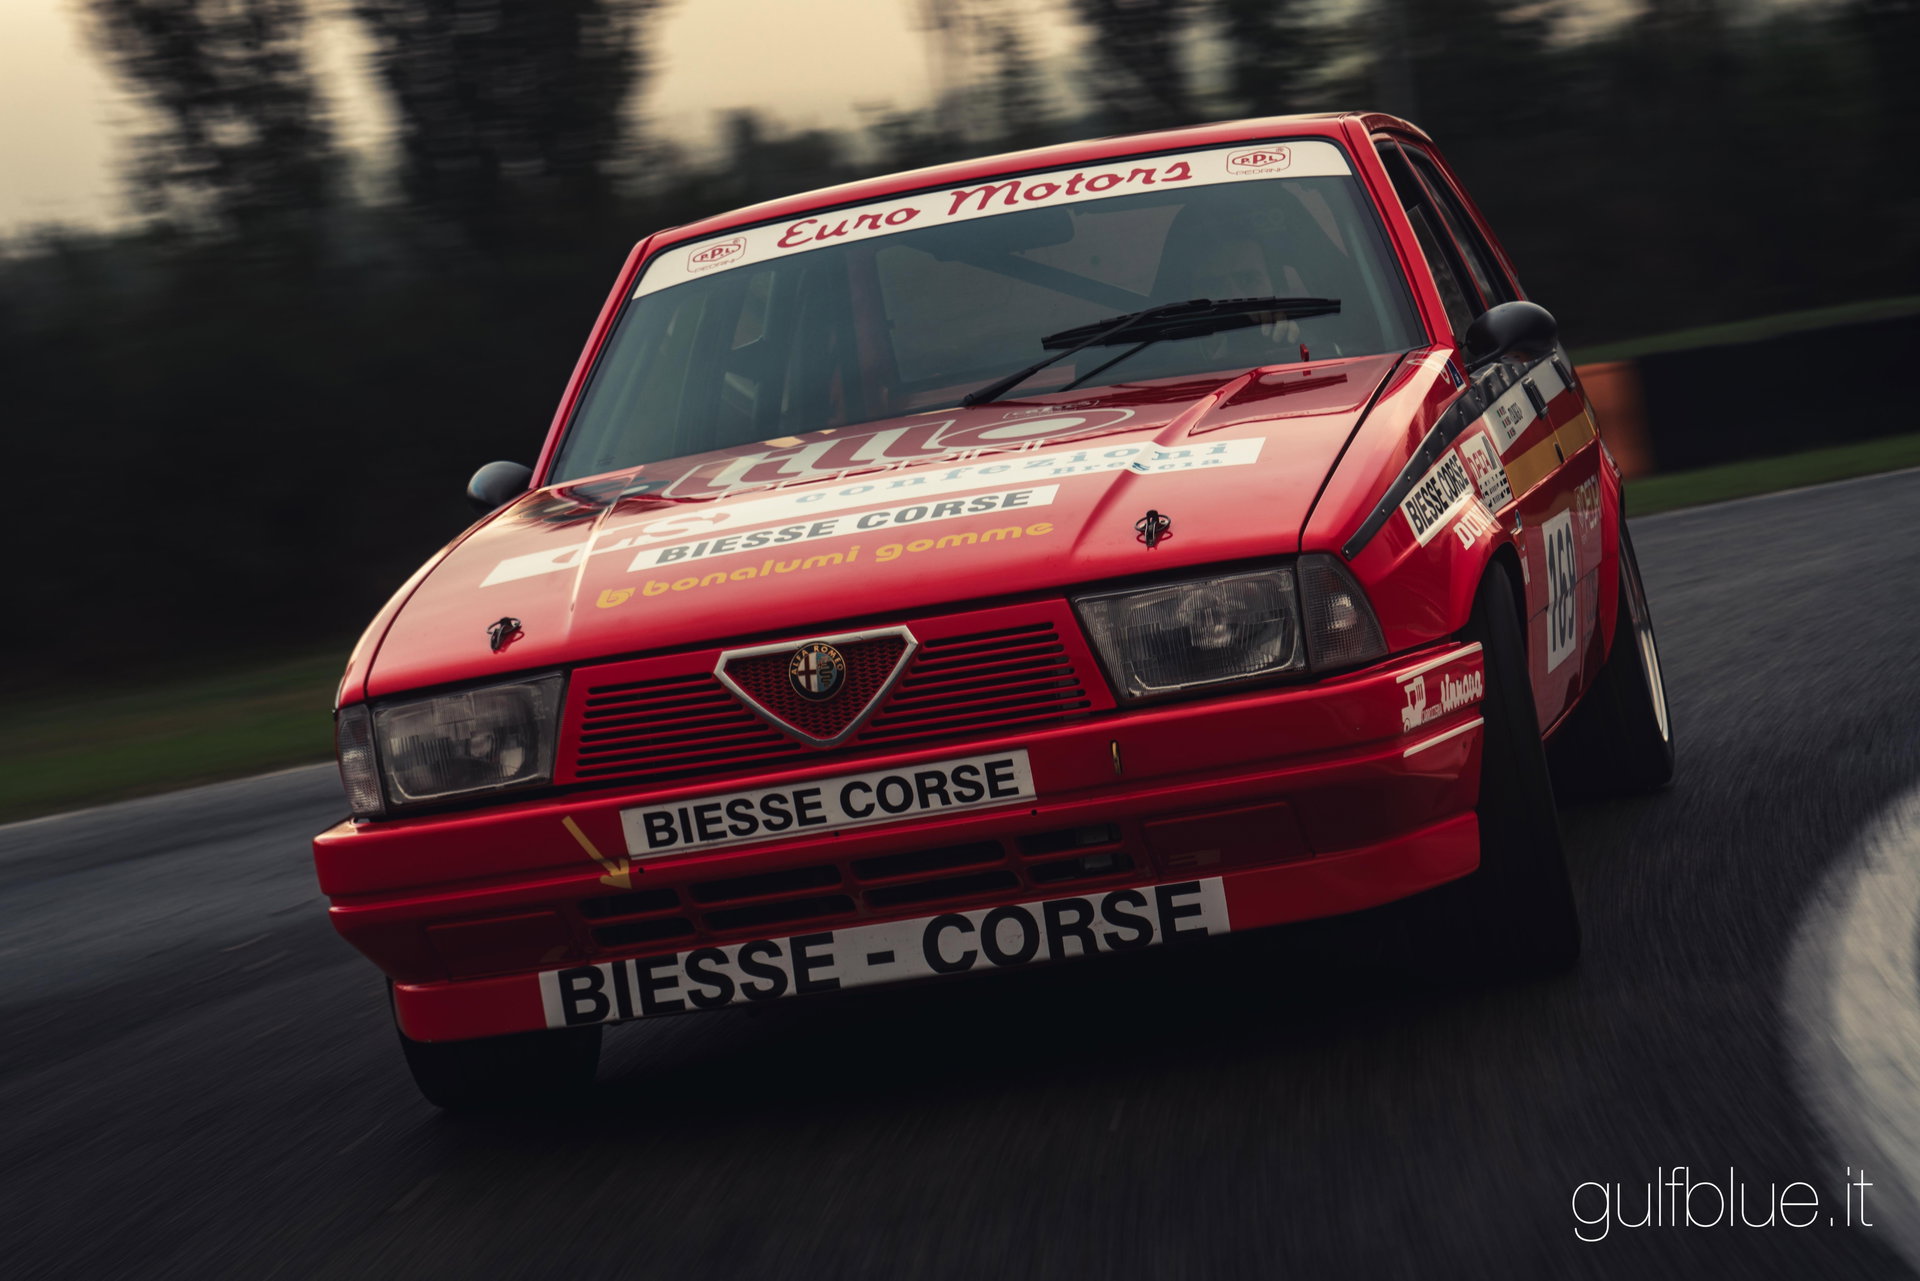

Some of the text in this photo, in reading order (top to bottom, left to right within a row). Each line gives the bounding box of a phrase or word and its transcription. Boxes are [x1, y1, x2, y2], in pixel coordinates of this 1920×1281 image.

[777, 161, 1192, 249] Euro Motors
[795, 442, 1230, 503] confezioni
[1405, 474, 1447, 536] BIESSE
[1439, 453, 1470, 500] CORSE
[642, 522, 1054, 597] bonalumi gomme
[654, 519, 839, 566] BIESSE
[856, 489, 1034, 530] CORSE
[1548, 522, 1576, 653] 169
[791, 646, 844, 675] ALFA ROMEO
[643, 759, 1019, 849] BIESSE CORSE
[557, 931, 841, 1027] BIESSE
[921, 881, 1210, 974] CORSE
